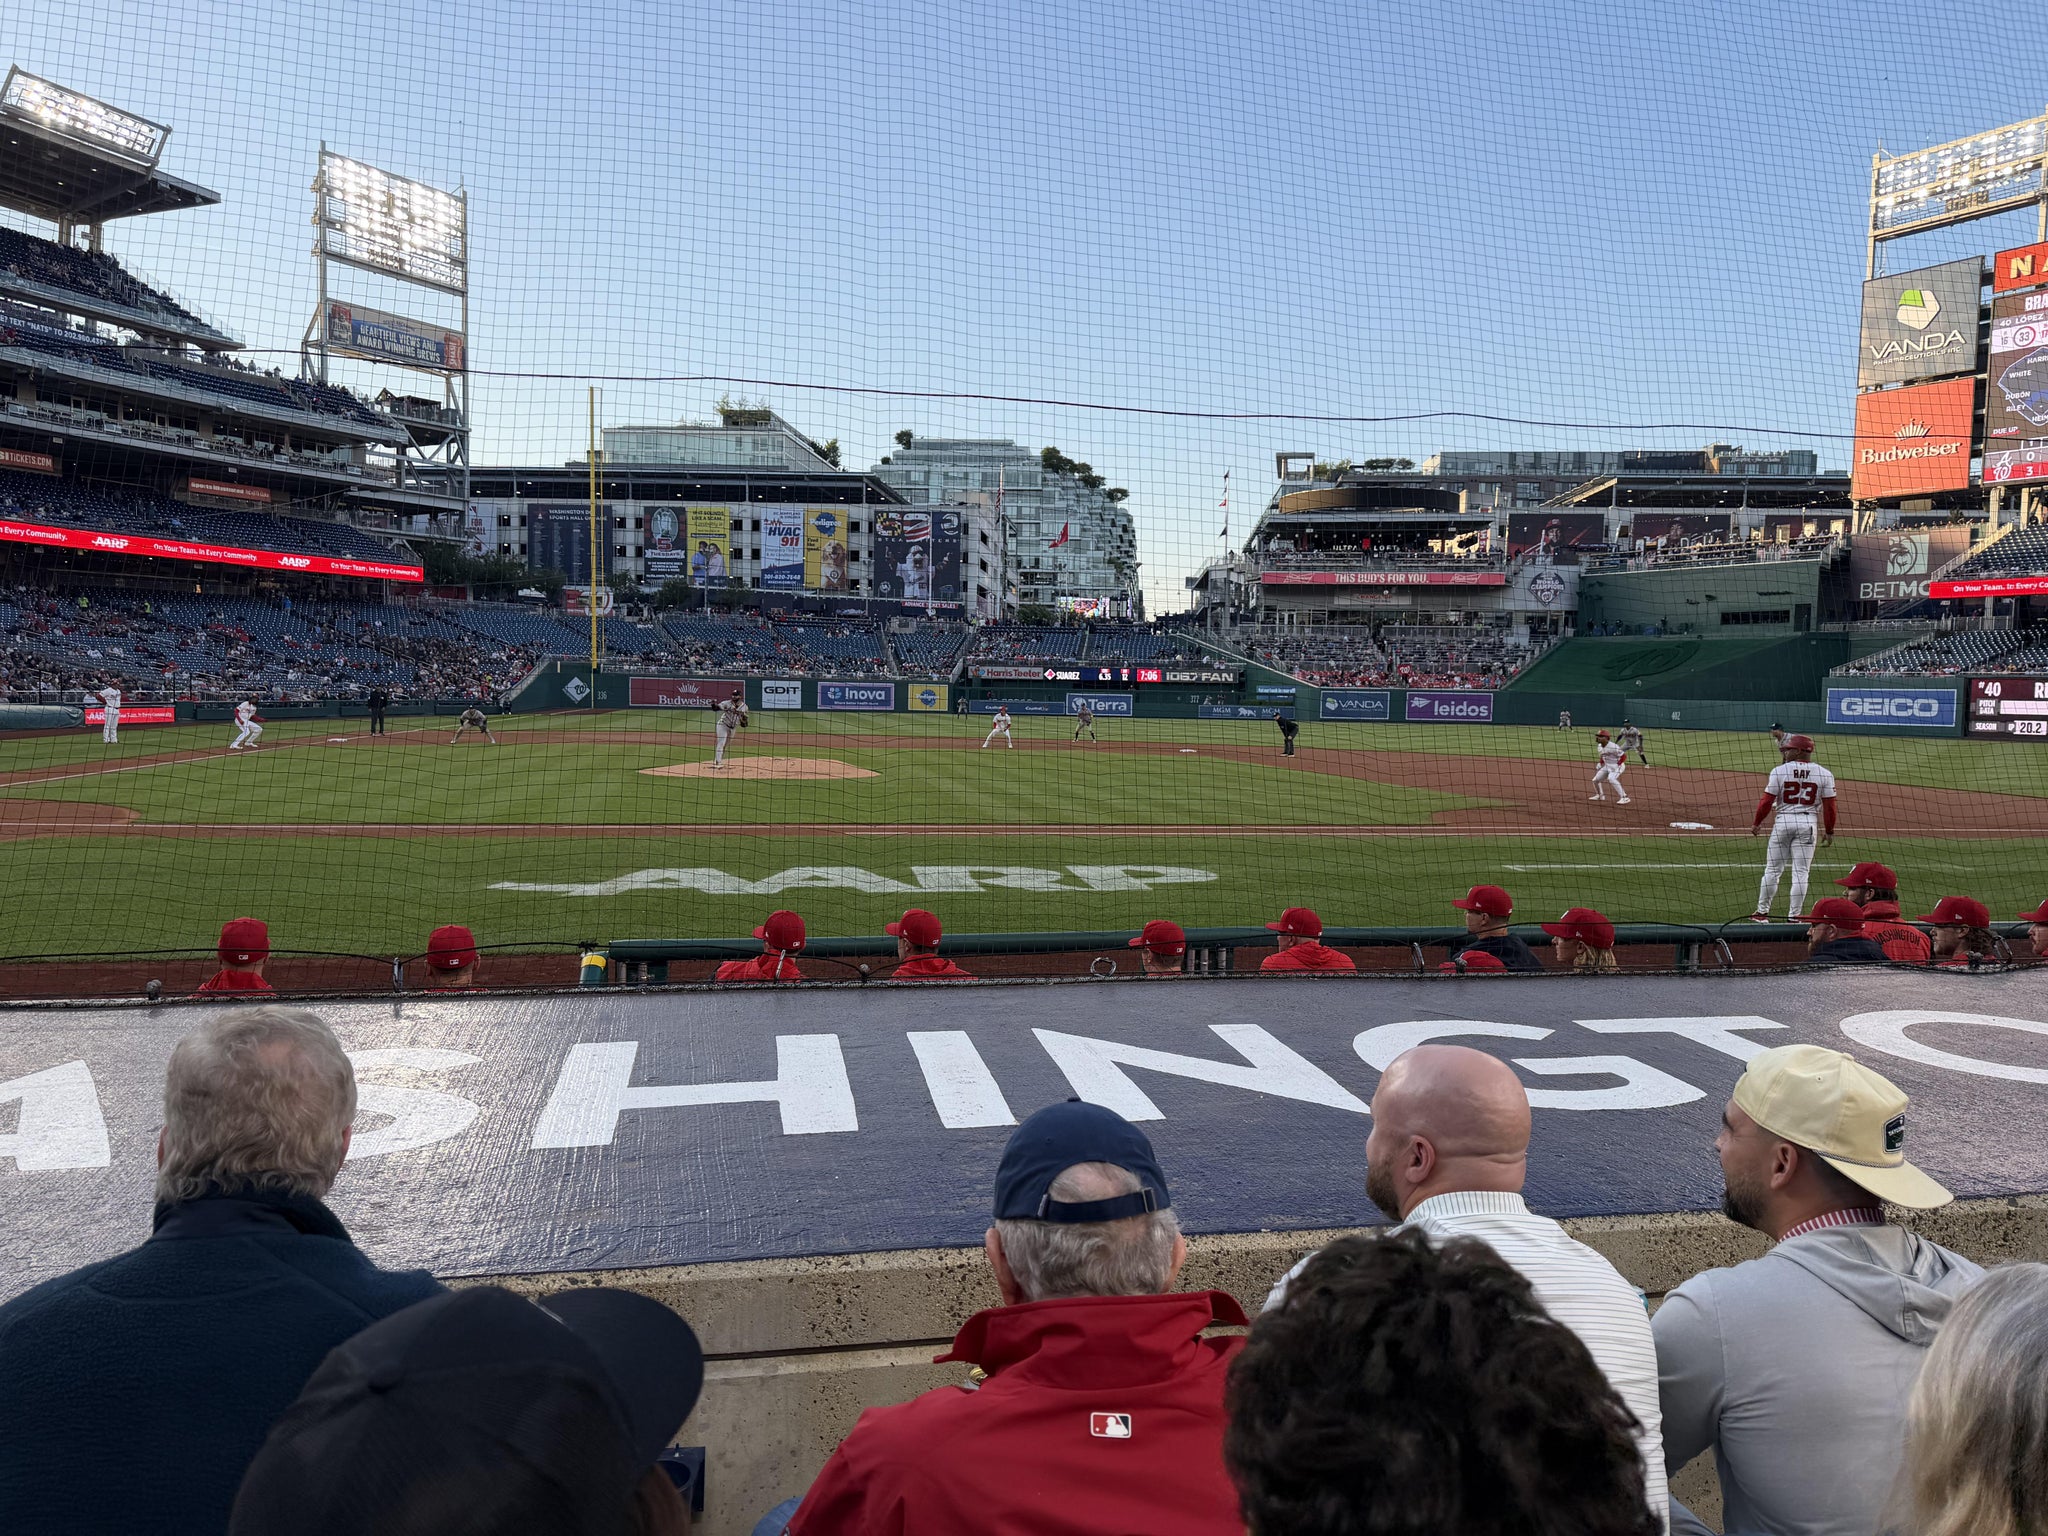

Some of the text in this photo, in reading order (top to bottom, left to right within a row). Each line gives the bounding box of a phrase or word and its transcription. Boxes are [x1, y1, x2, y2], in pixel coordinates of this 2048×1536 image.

[1999, 313, 2045, 327] 40 LÓPEZ
[9, 317, 25, 329] TEXT
[54, 328, 64, 336] TO
[398, 332, 421, 348] VIEWS
[2019, 331, 2030, 342] 33
[357, 334, 383, 351] AWARD
[1869, 329, 1967, 360] VANDA
[2009, 369, 2032, 379] WHITE
[2006, 404, 2025, 413] RILEY
[1860, 441, 1964, 465] Budweiser
[2026, 451, 2035, 461] 0
[2026, 466, 2034, 476] 3
[809, 518, 842, 528] Pedigree
[768, 526, 801, 537] HVAC
[781, 536, 800, 547] 911
[4, 526, 25, 537] Every
[26, 528, 68, 542] Community.
[92, 536, 129, 549] AARP
[164, 544, 179, 552] Your
[179, 546, 198, 554] Team.
[206, 549, 222, 559] Every
[223, 550, 258, 562] Community.
[278, 556, 311, 568] AARP
[375, 567, 389, 576] Every
[1358, 573, 1385, 583] BUD'S
[1387, 573, 1405, 583] FOR
[1407, 573, 1429, 583] YOU.
[1953, 585, 1963, 593] On
[1964, 584, 1982, 593] Your
[1983, 584, 2005, 592] Team.
[2015, 582, 2037, 591] Every
[986, 668, 1041, 678] Harris Teeter
[1056, 670, 1158, 681] SUAREZ 6.35 12 7:06
[1201, 672, 1234, 682] FAN
[763, 686, 800, 695] GDIT
[845, 687, 885, 701] Inova
[1088, 699, 1127, 711] Terra
[1190, 695, 1200, 704] 377
[1338, 700, 1384, 709] VANDA
[1433, 700, 1488, 717] leidos
[1840, 697, 1939, 717] GEICO
[87, 712, 105, 720] AAR
[1975, 723, 1997, 731] SEASON
[2020, 722, 2042, 734] 20.2
[1793, 769, 1811, 779] RAY
[1782, 781, 1819, 806] 23
[486, 865, 1219, 896] AARP
